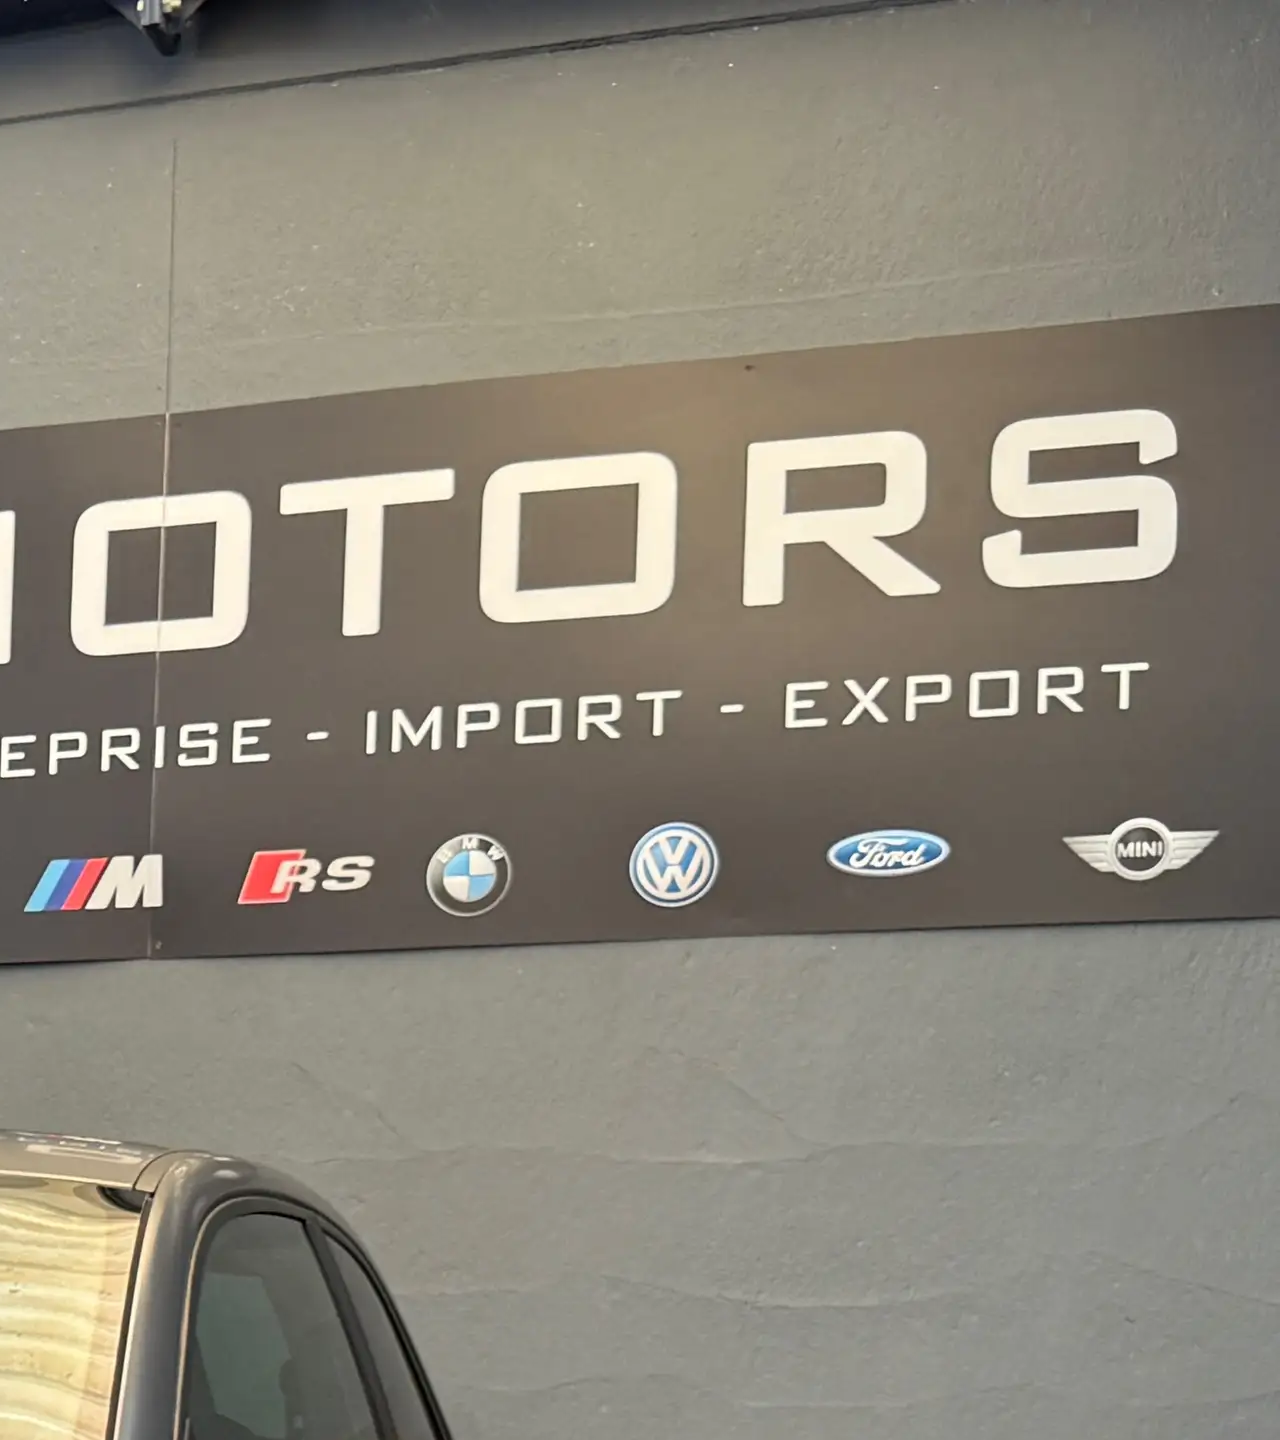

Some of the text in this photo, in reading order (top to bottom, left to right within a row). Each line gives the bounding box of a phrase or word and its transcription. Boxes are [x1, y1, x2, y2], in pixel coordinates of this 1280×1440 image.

[364, 690, 683, 755] IMPORT
[784, 662, 1150, 728] EXPORT
[850, 837, 927, 869] Ford
[1117, 840, 1162, 859] MINI
[269, 855, 375, 894] RS
